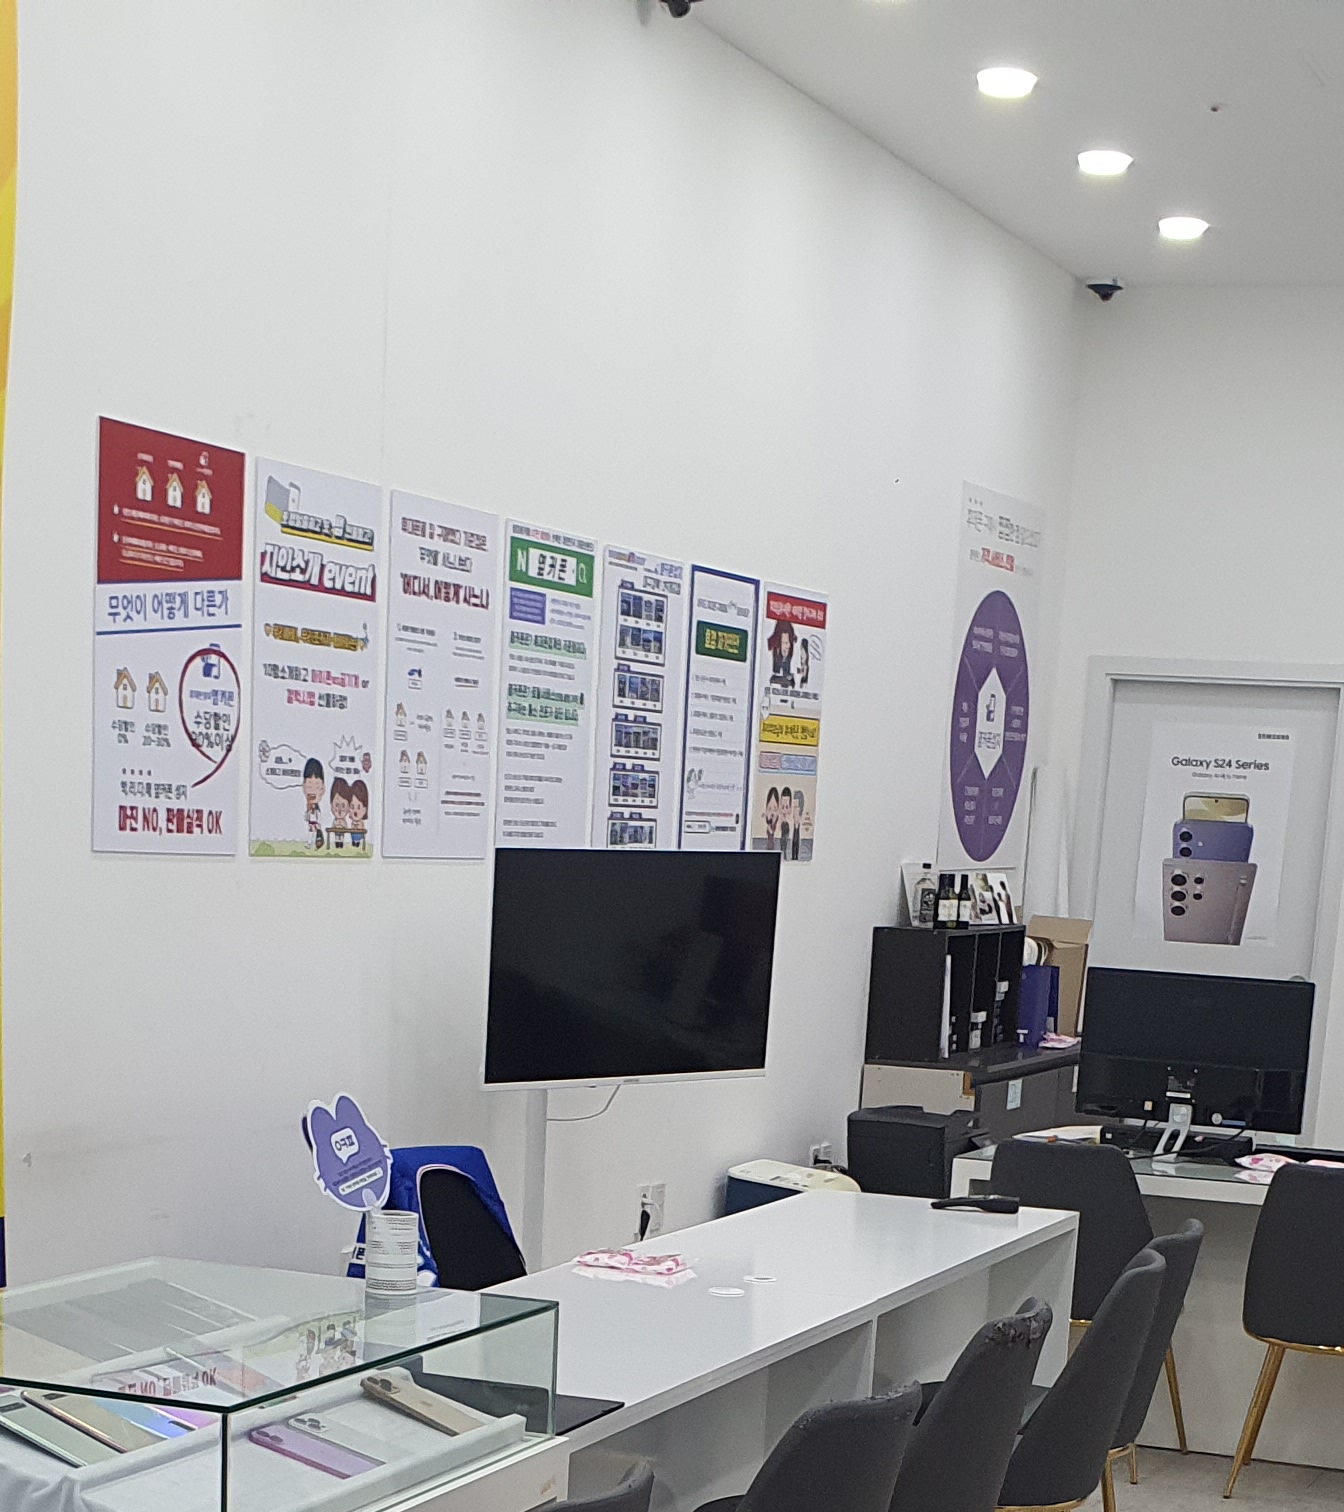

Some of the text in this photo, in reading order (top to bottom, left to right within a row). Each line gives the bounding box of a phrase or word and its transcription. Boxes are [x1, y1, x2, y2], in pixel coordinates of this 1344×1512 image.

[262, 543, 374, 596] 지인소개 event
[108, 589, 229, 622] 무엇이 어떻게 다른가
[1172, 756, 1269, 770] Galaxy S24 Series
[207, 811, 222, 834] OK
